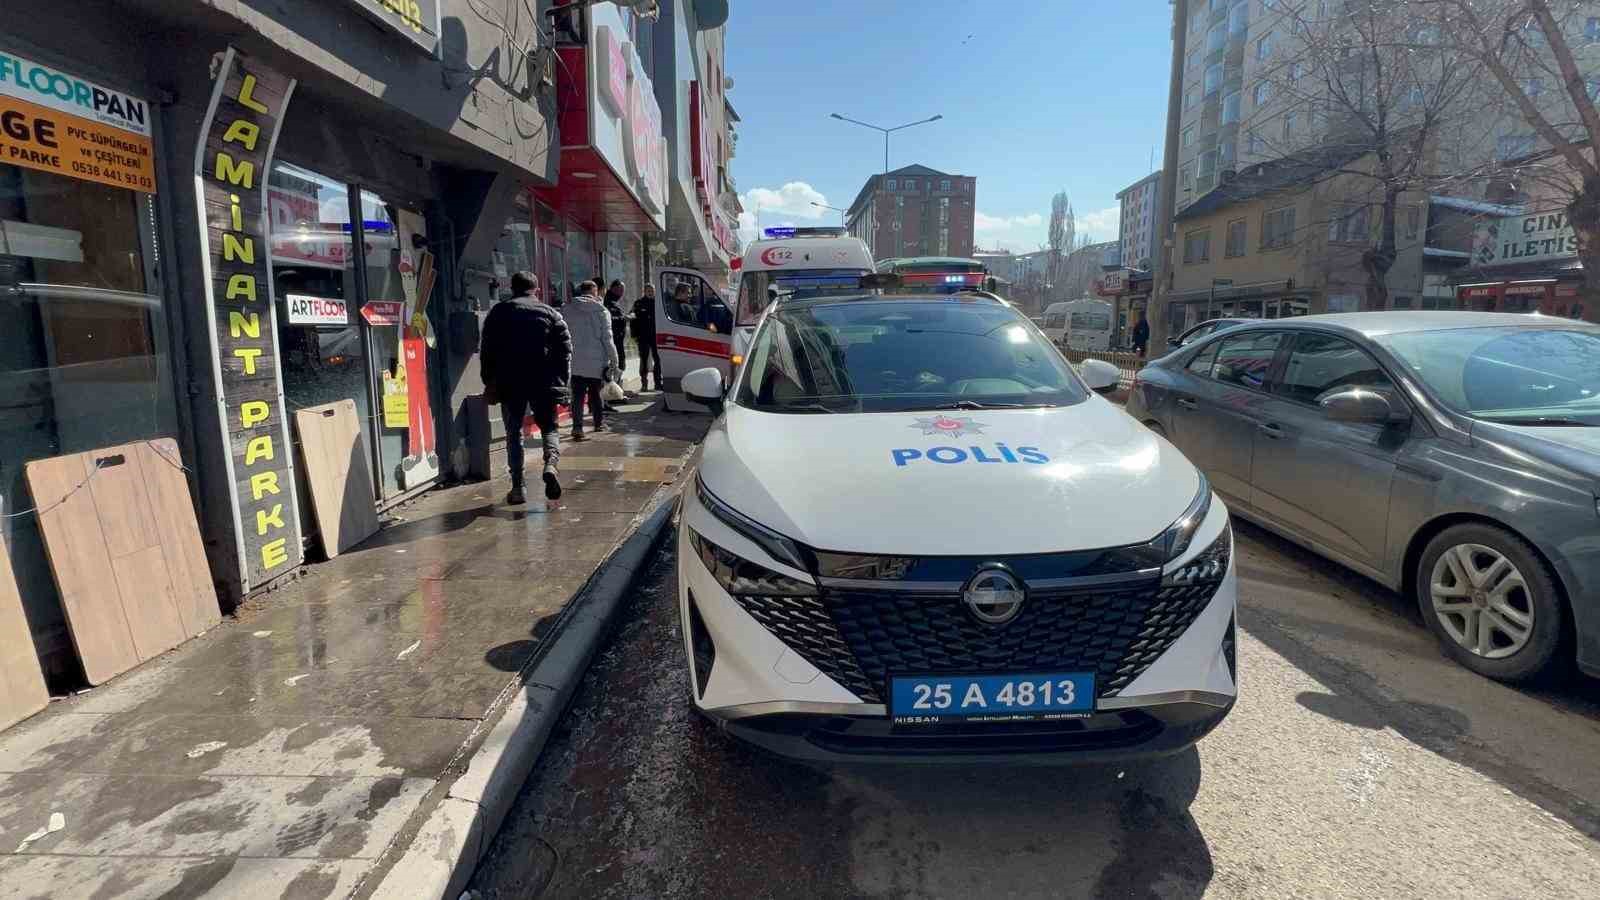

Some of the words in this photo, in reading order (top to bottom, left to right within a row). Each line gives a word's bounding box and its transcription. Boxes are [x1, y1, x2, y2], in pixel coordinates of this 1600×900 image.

[0, 110, 58, 149] GE
[67, 126, 88, 141] PVC
[9, 146, 61, 168] PARKE
[103, 167, 122, 182] 441
[125, 172, 138, 185] 93
[140, 175, 152, 189] 03
[769, 251, 793, 260] 112
[291, 299, 345, 316] ARTFLOOR
[891, 441, 1050, 467] POLİS
[240, 400, 288, 570] PARKE
[912, 684, 952, 709] 25
[961, 683, 988, 708] A
[996, 680, 1075, 706] 4813
[894, 716, 939, 724] NISSAN
